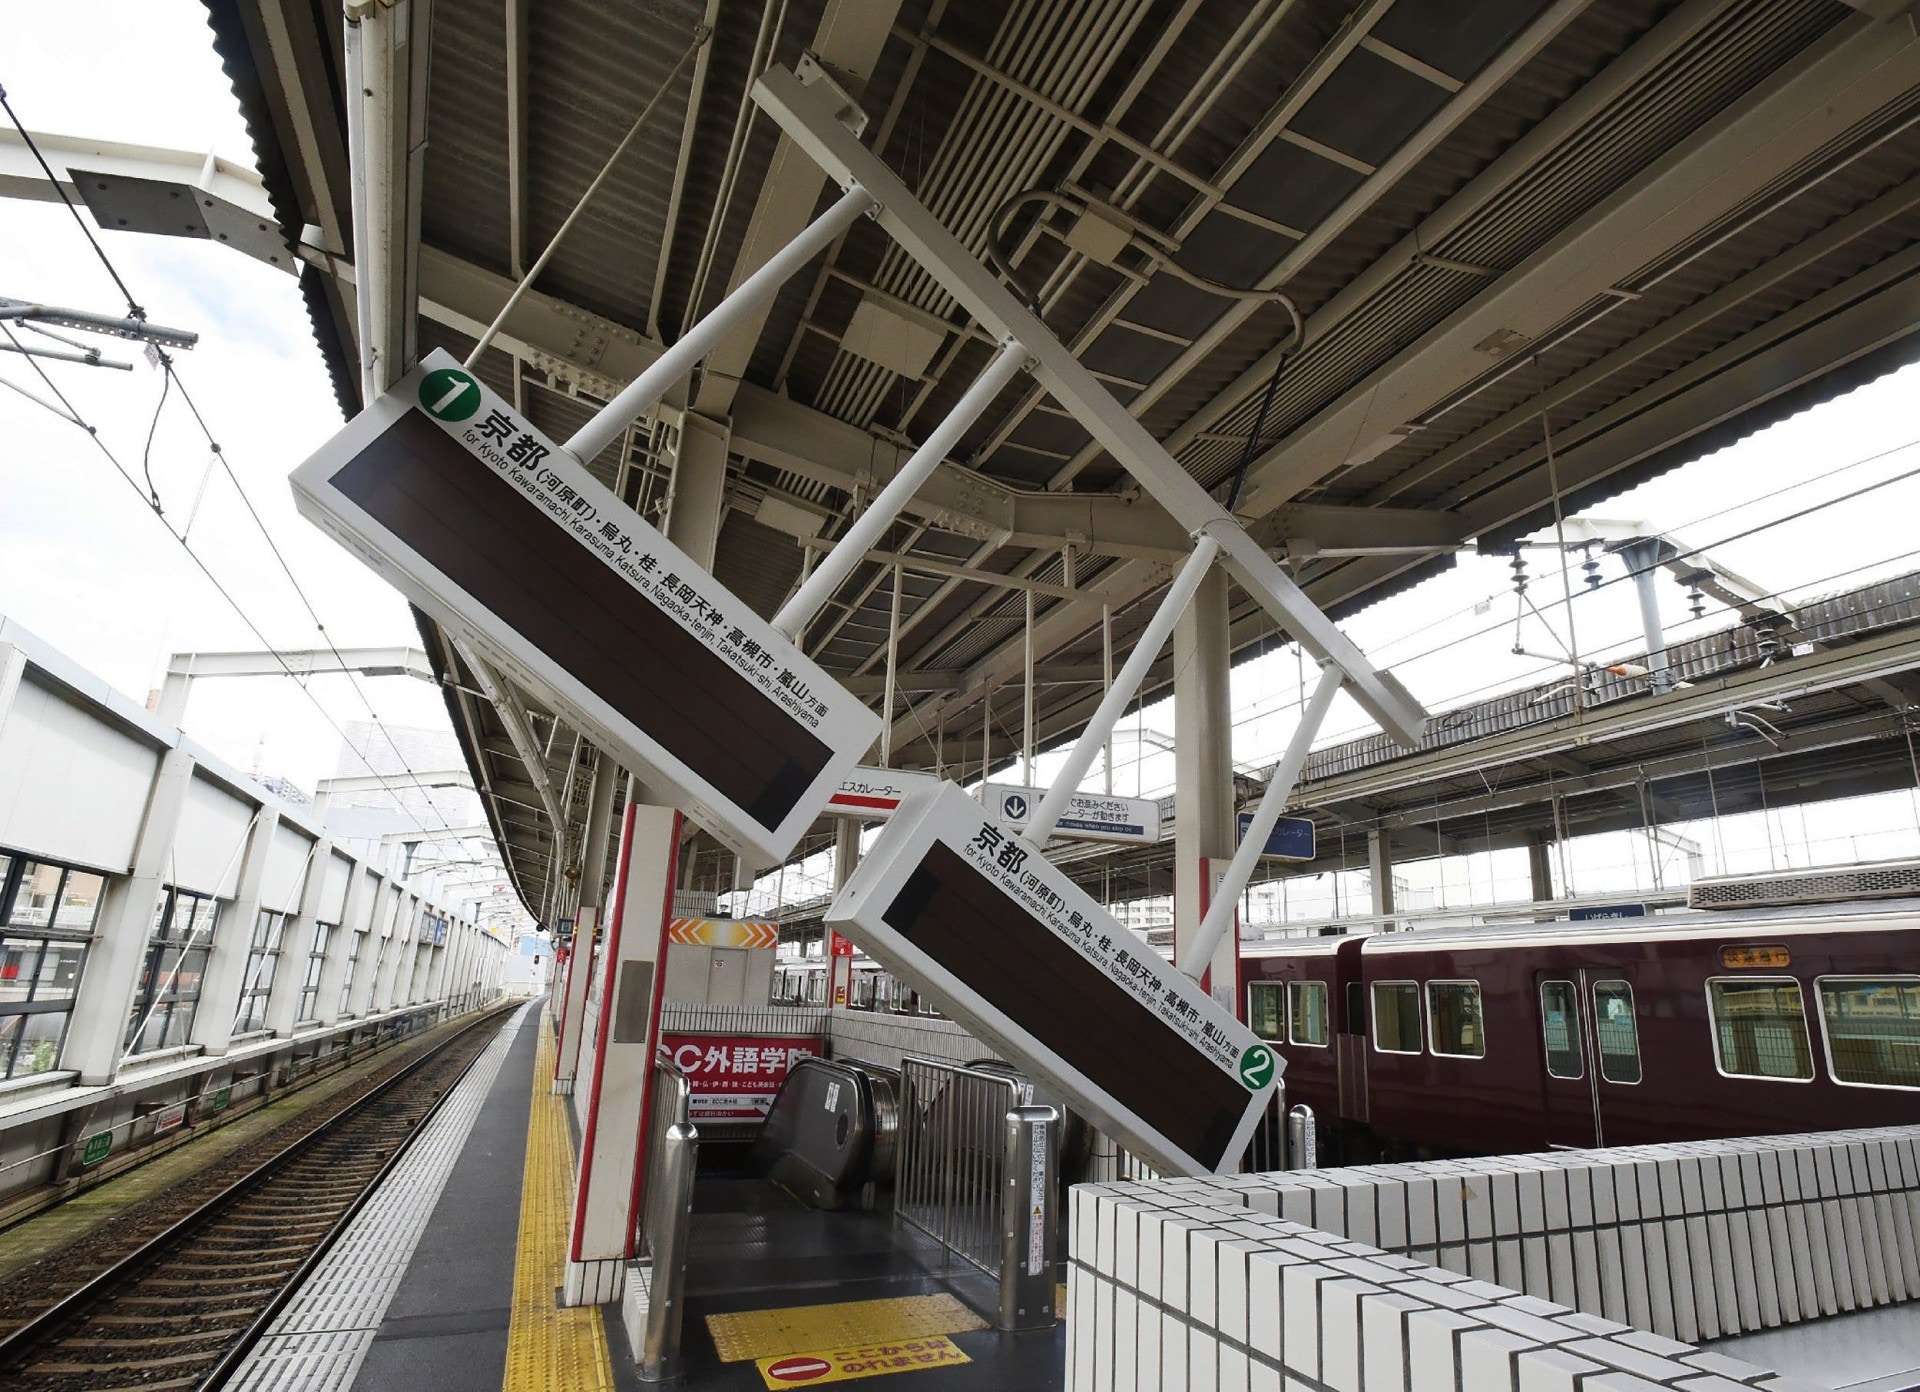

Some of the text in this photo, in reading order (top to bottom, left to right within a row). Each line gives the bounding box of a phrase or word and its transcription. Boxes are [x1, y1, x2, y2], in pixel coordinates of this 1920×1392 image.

[430, 376, 471, 414] 1
[462, 428, 820, 728] for Kyoto Kawaramachi, Karasuma, Katsura, Nagaoka-tenjin, Takatsuki-shi, Arashiyama
[838, 781, 901, 796] エスカレーター
[963, 843, 1234, 1069] for Kyoto Kawaramachi, Karasuma, Katsura, Nagaoka-tenjin, Takatsuki-shi, Arashiyama
[1242, 1049, 1270, 1087] 2
[833, 1339, 949, 1362] ここからは
[842, 1350, 960, 1374] のれません
